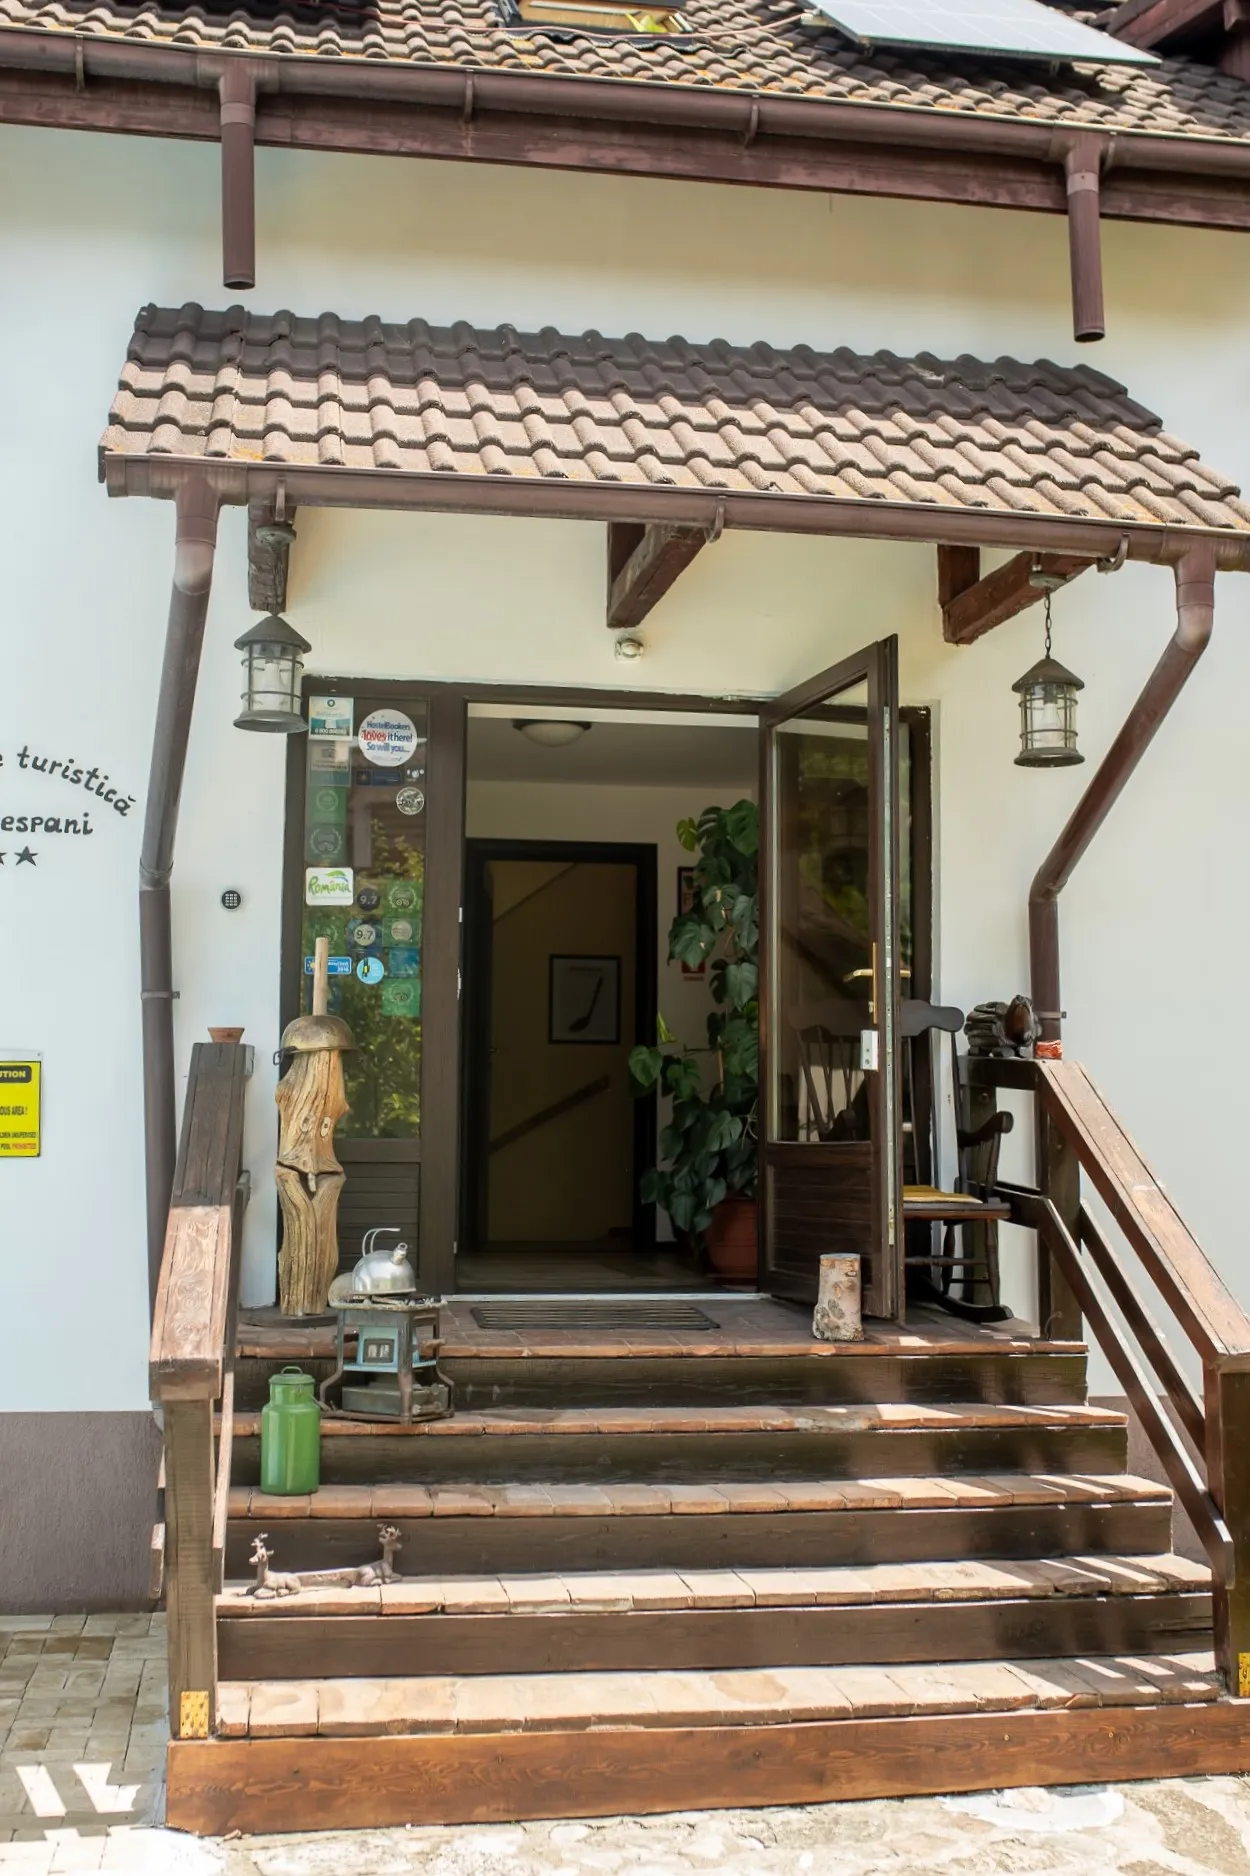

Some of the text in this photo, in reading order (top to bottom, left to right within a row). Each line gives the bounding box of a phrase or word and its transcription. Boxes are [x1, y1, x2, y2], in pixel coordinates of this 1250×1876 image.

[17, 745, 136, 817] turistică
[359, 895, 378, 905] 9.7
[355, 930, 374, 940] 9.7
